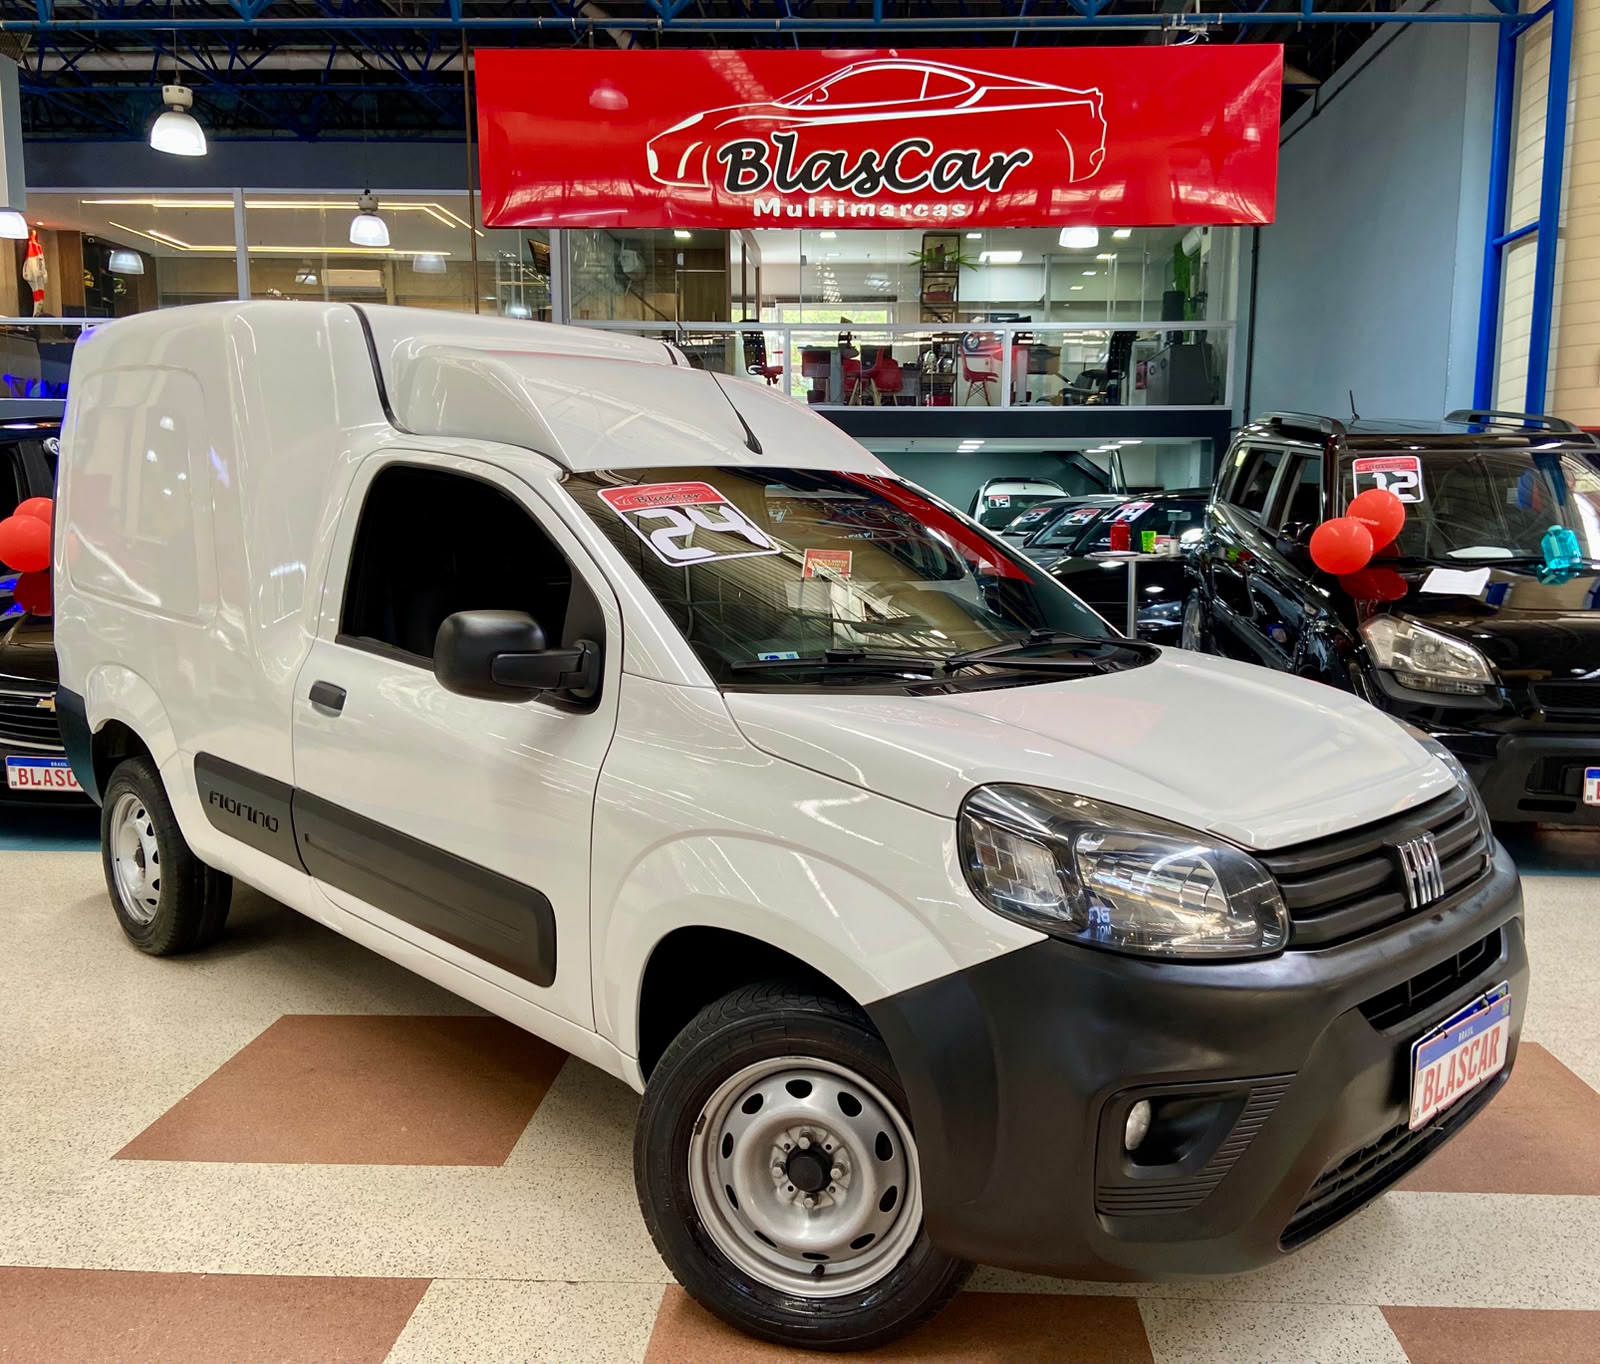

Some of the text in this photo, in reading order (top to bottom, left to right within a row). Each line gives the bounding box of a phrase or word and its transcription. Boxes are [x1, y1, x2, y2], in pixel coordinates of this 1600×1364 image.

[717, 131, 1033, 196] BlasCar
[754, 198, 968, 218] Multimarcas
[1372, 471, 1418, 500] 12
[633, 505, 770, 560] 24
[1458, 1025, 1474, 1042] BRASIL
[1421, 1026, 1501, 1113] BLASCAR
